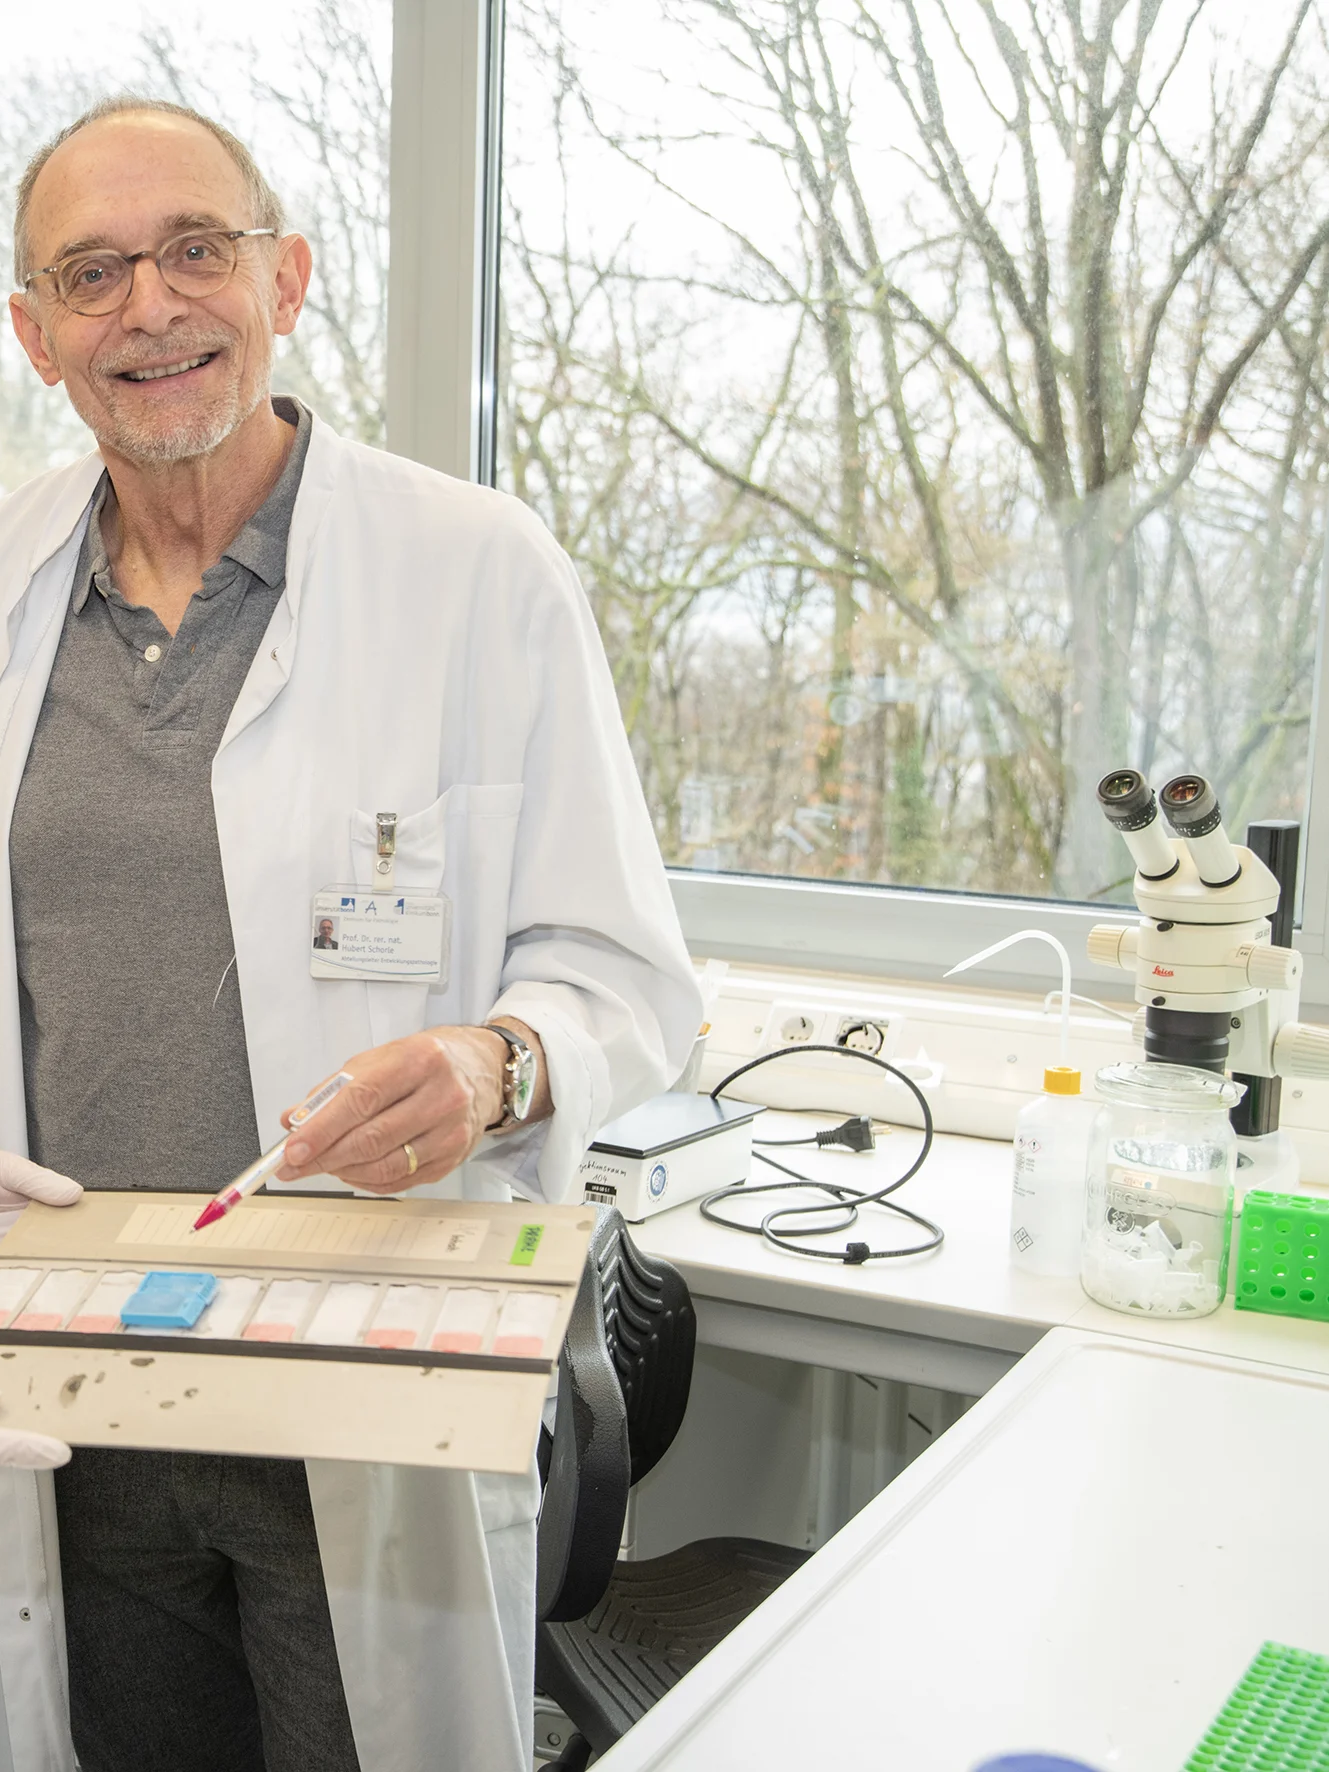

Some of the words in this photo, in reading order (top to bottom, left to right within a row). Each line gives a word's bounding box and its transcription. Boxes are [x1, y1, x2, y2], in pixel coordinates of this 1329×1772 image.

[342, 934, 358, 942] Prof.
[361, 935, 371, 943] Dr.
[388, 936, 402, 944] nat.
[342, 945, 366, 953] Hubert
[1152, 965, 1174, 977] Leica
